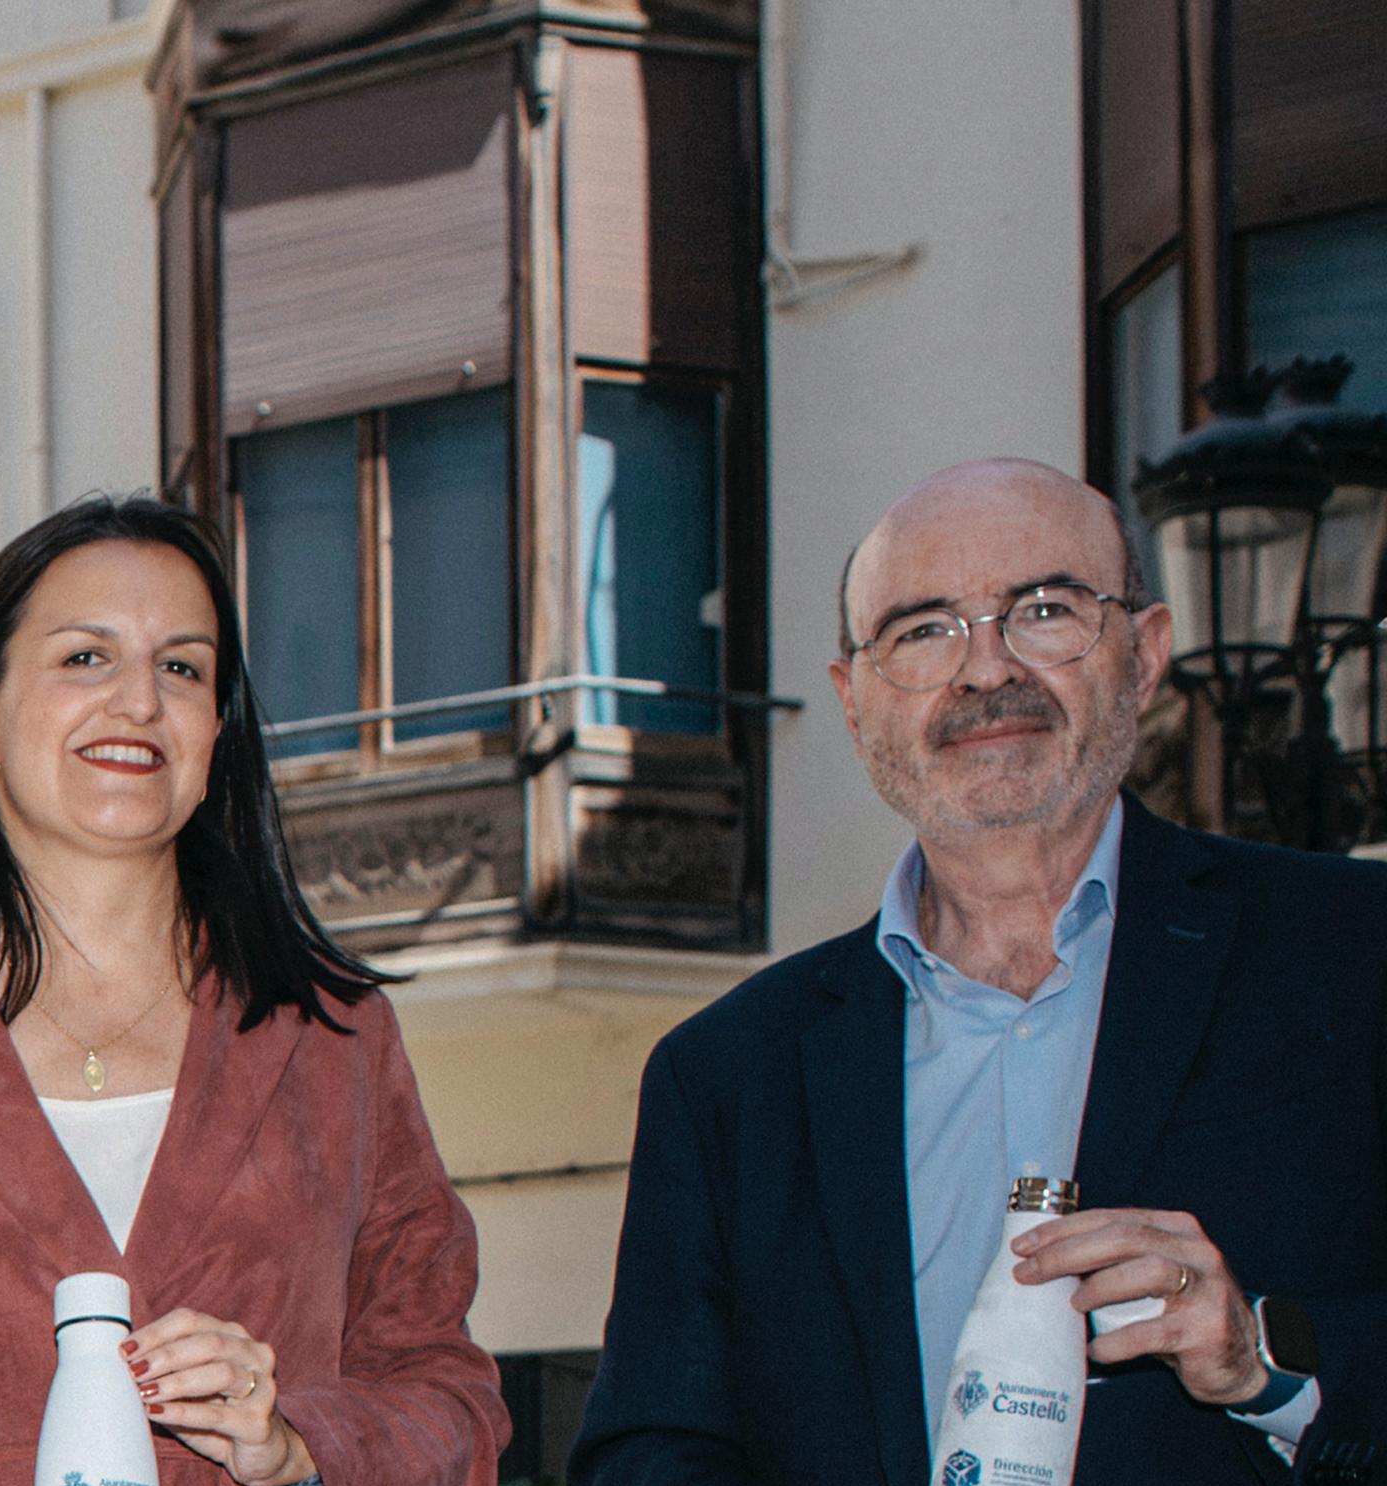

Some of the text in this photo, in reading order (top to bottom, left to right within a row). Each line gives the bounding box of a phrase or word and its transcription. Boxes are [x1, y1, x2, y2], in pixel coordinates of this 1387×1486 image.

[995, 1381, 1056, 1399] Ajuntament
[993, 1394, 1067, 1423] Castelló
[993, 1457, 1053, 1478] Dirección
